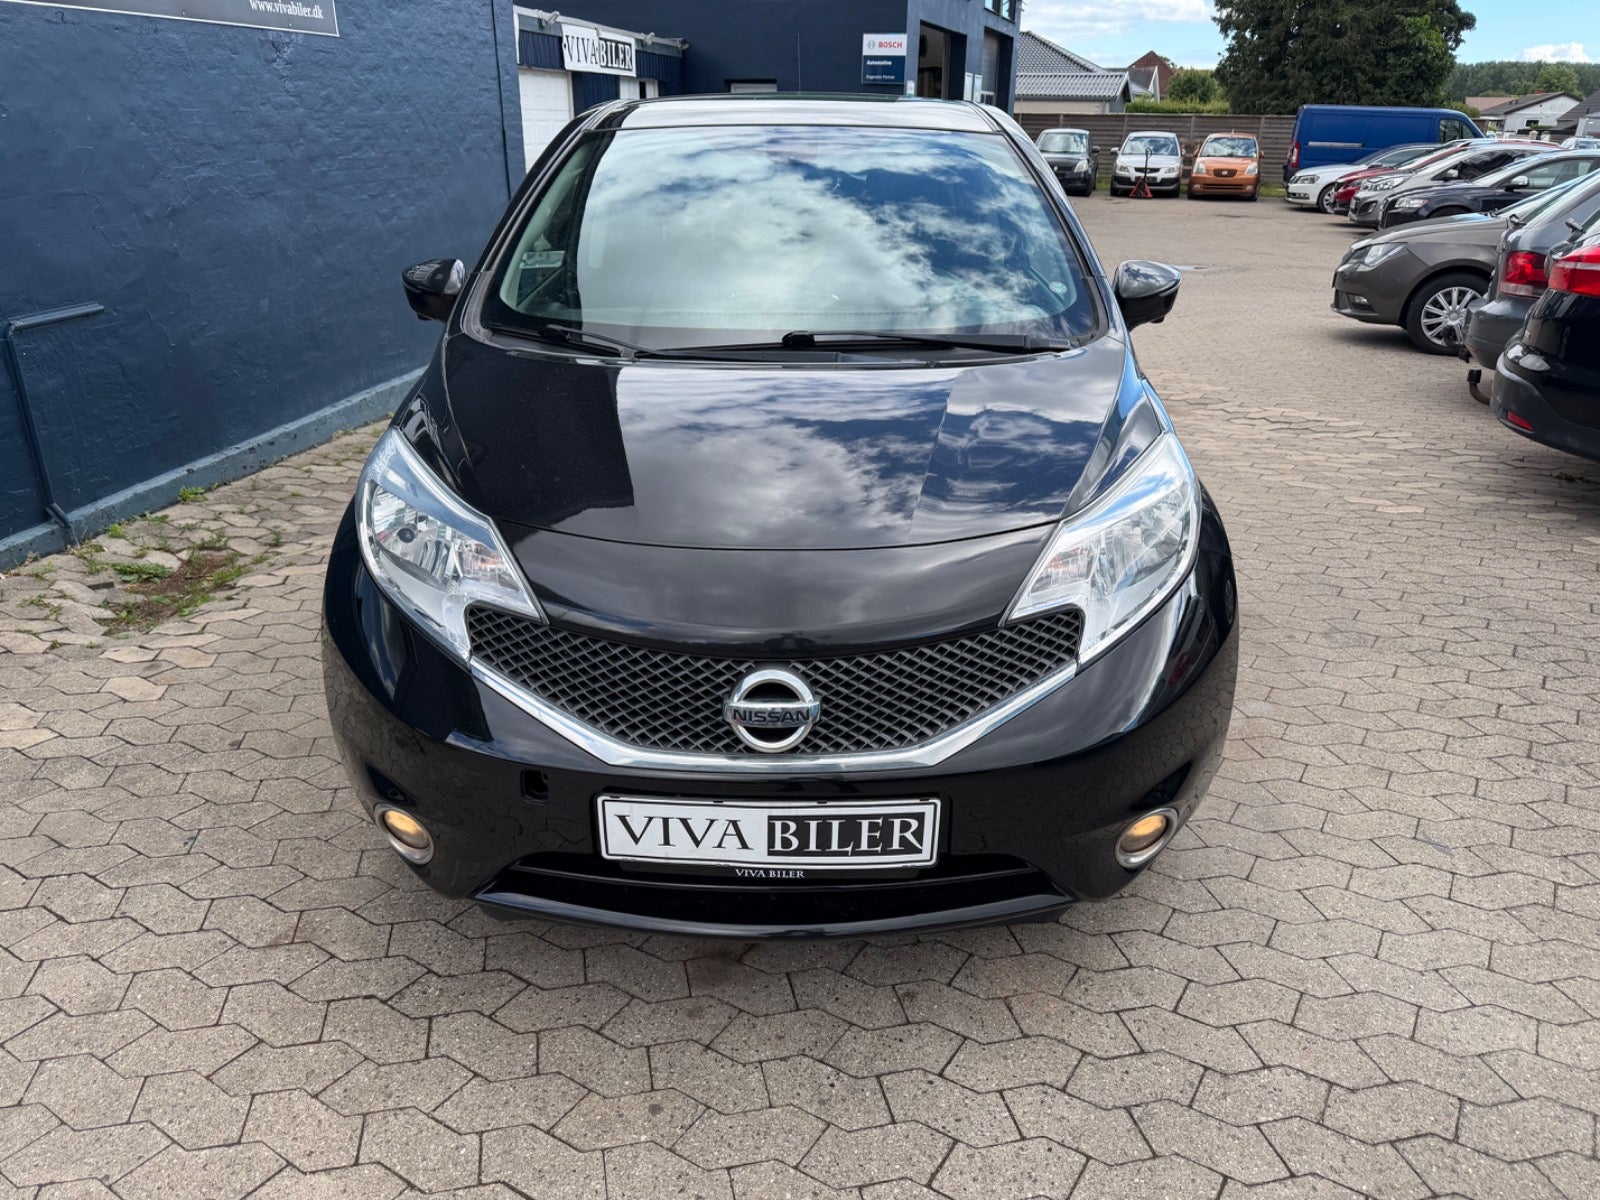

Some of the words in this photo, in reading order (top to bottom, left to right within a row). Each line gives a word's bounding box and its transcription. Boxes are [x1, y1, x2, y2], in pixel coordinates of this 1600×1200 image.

[249, 0, 324, 19] www.vivabiler.dk
[565, 35, 598, 64] VIVA
[599, 40, 633, 69] BILER
[733, 708, 810, 722] NISSAN
[613, 815, 754, 850] VIVA
[769, 816, 924, 857] BILER
[735, 868, 766, 878] VIVA
[769, 869, 805, 879] BILER
